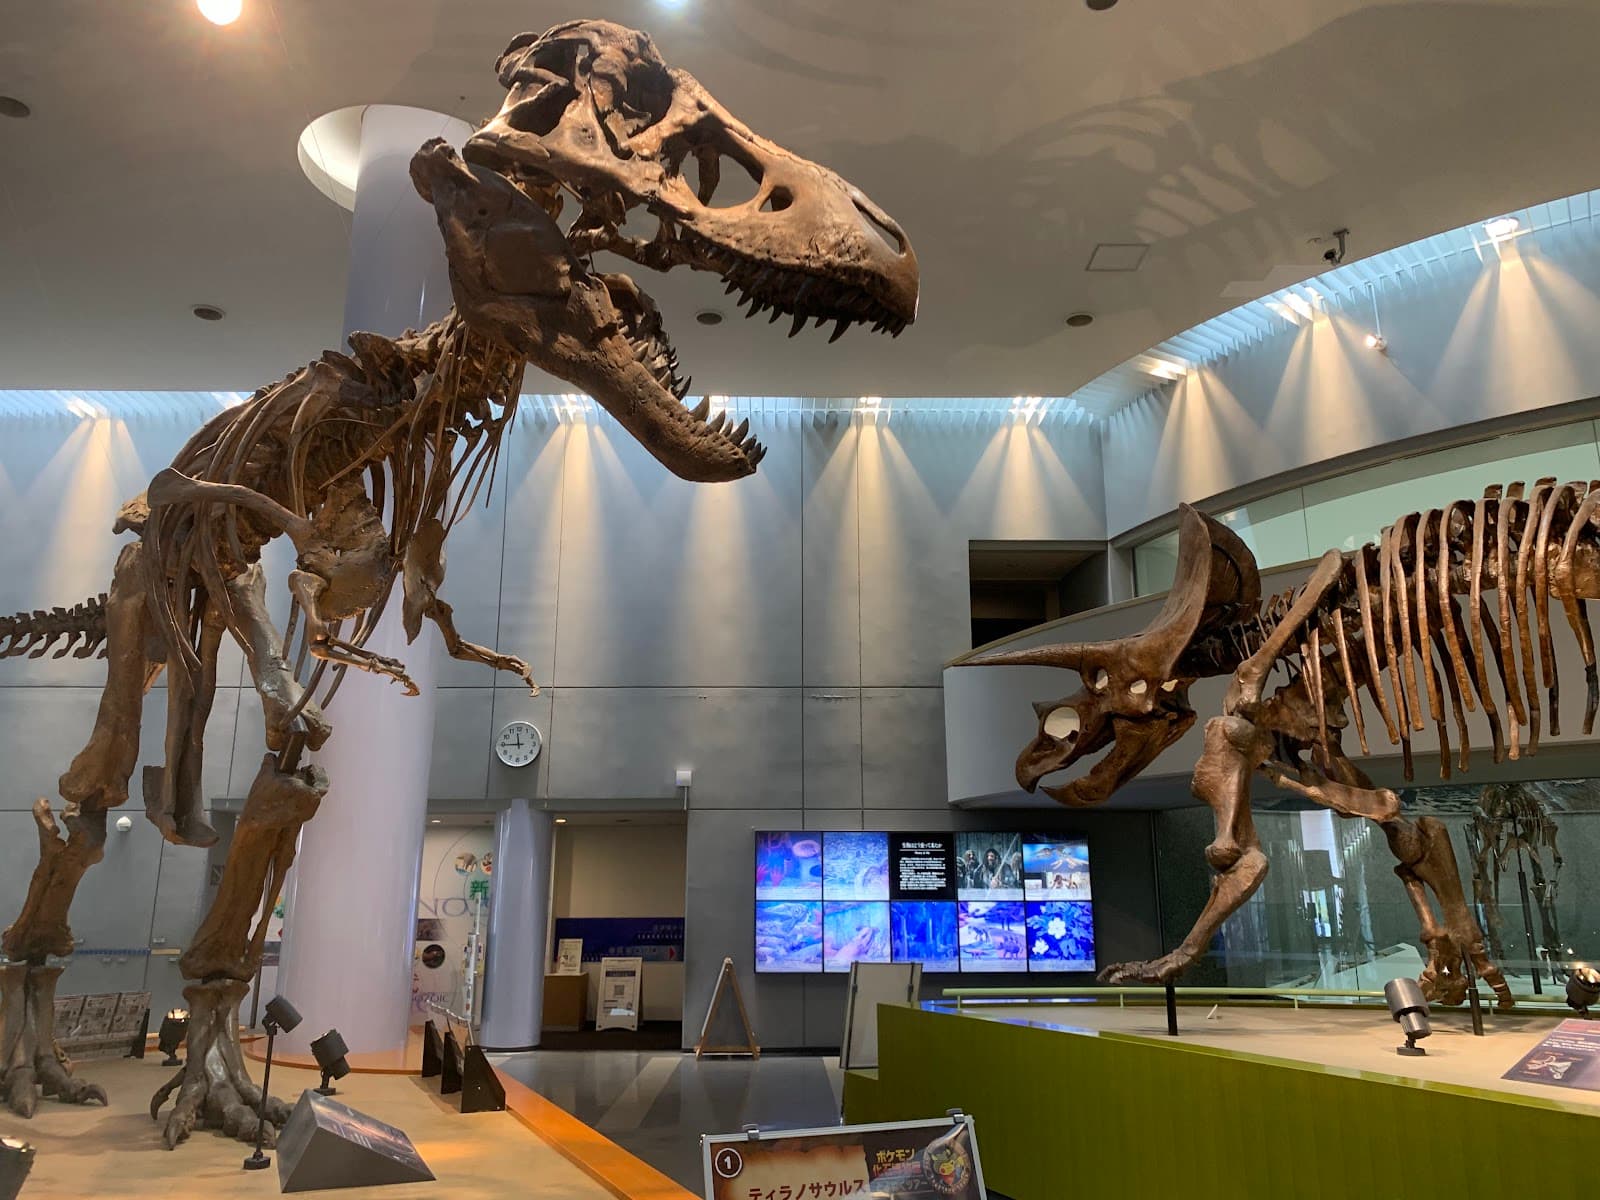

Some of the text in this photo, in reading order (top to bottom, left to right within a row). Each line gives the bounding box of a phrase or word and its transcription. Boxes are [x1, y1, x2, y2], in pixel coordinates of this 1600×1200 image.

[723, 1156, 732, 1170] 1
[876, 1148, 915, 1163] ポケモン
[748, 1179, 866, 1200] ティラノサウルス
